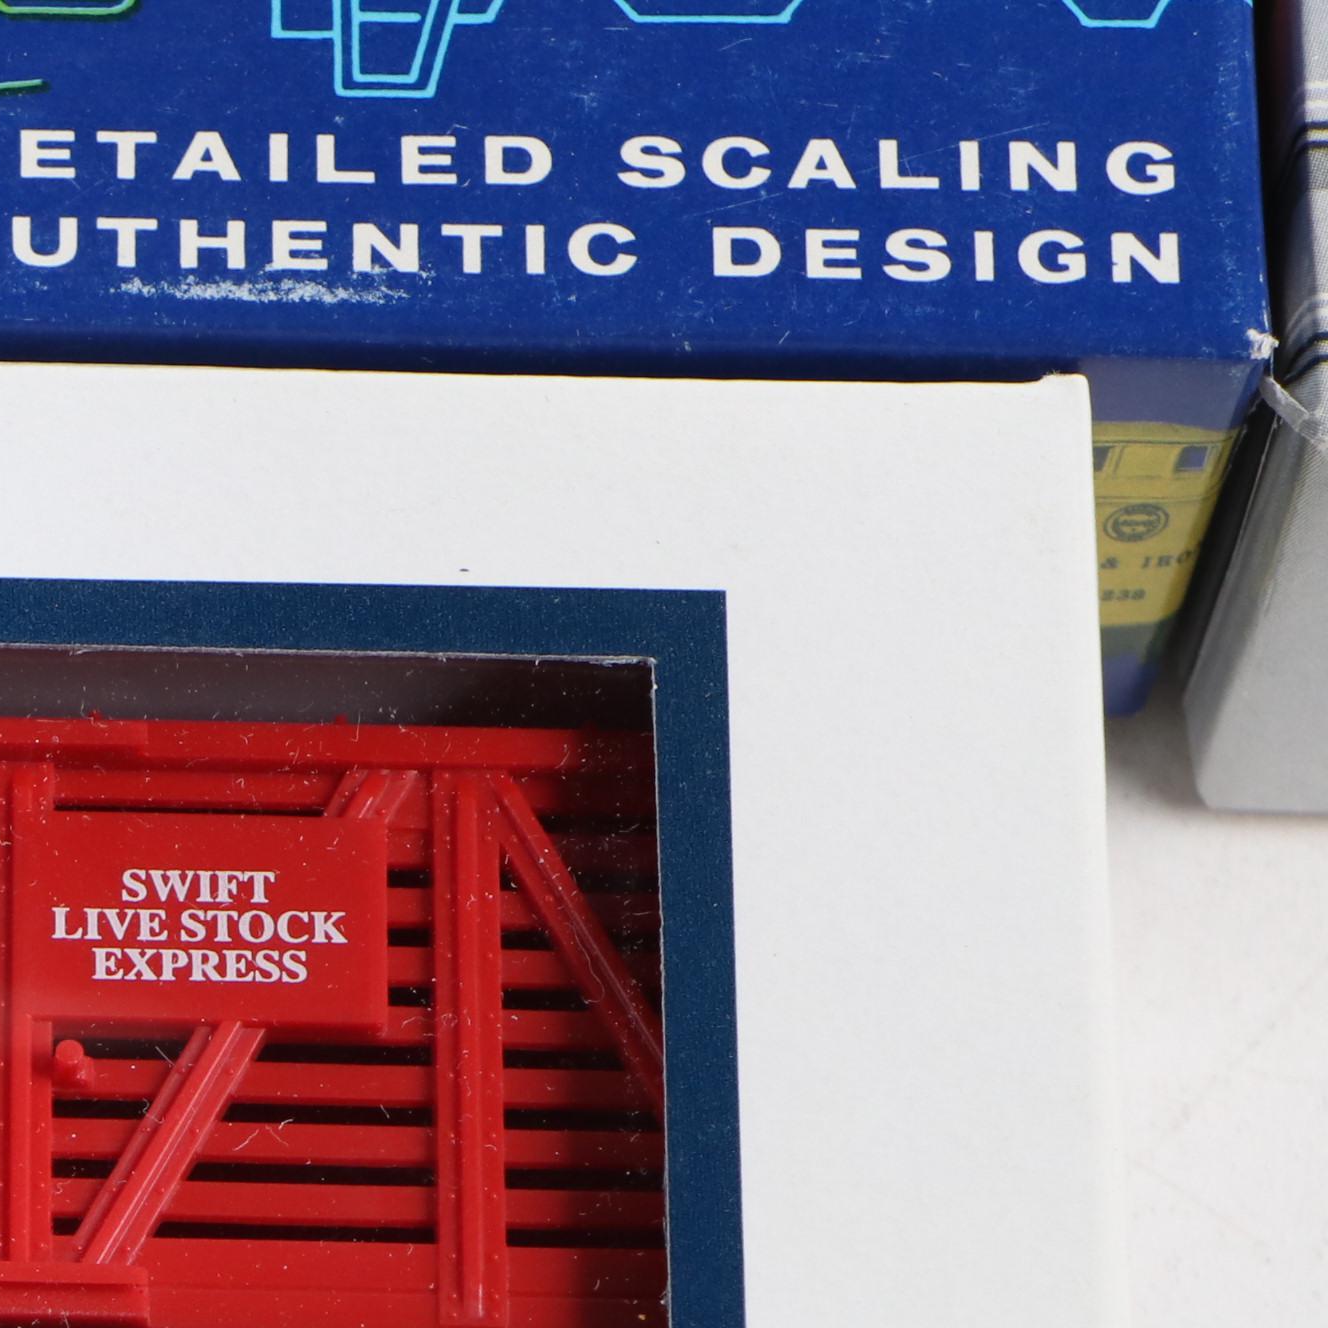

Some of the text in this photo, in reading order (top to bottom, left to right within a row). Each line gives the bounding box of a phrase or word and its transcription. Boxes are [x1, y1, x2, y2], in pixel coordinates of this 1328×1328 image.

[616, 135, 1176, 196] SCALING
[711, 225, 1181, 284] DESIGN
[120, 867, 277, 904] SWIFT
[50, 905, 349, 945] LIVE STOCK
[90, 946, 309, 984] EXPRESS
